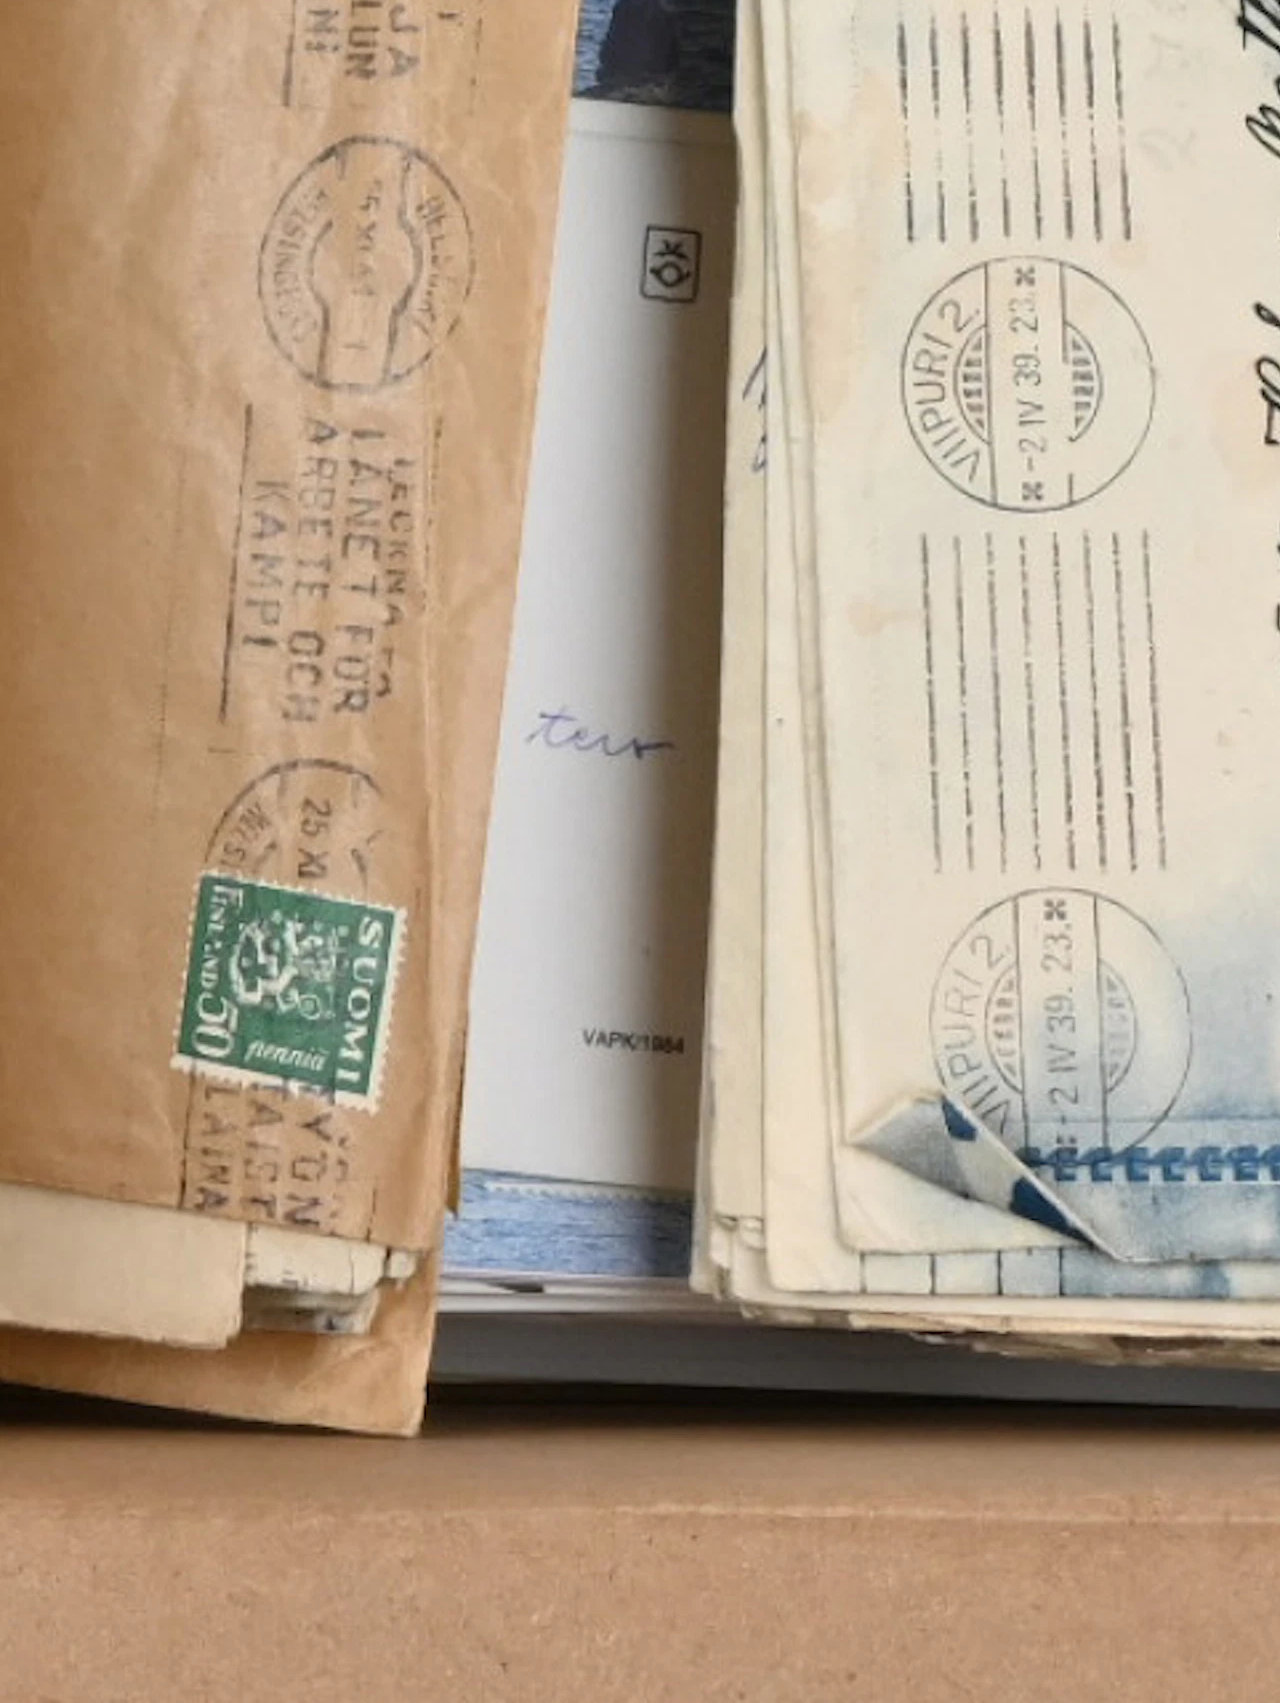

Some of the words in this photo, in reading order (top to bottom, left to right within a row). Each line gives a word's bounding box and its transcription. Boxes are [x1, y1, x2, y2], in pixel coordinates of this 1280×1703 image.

[912, 333, 986, 486] VIIPURI
[281, 629, 325, 724] OCH
[190, 994, 239, 1061] 50
[334, 916, 385, 1083] SUOMI
[944, 971, 1007, 1138] VIIPURI
